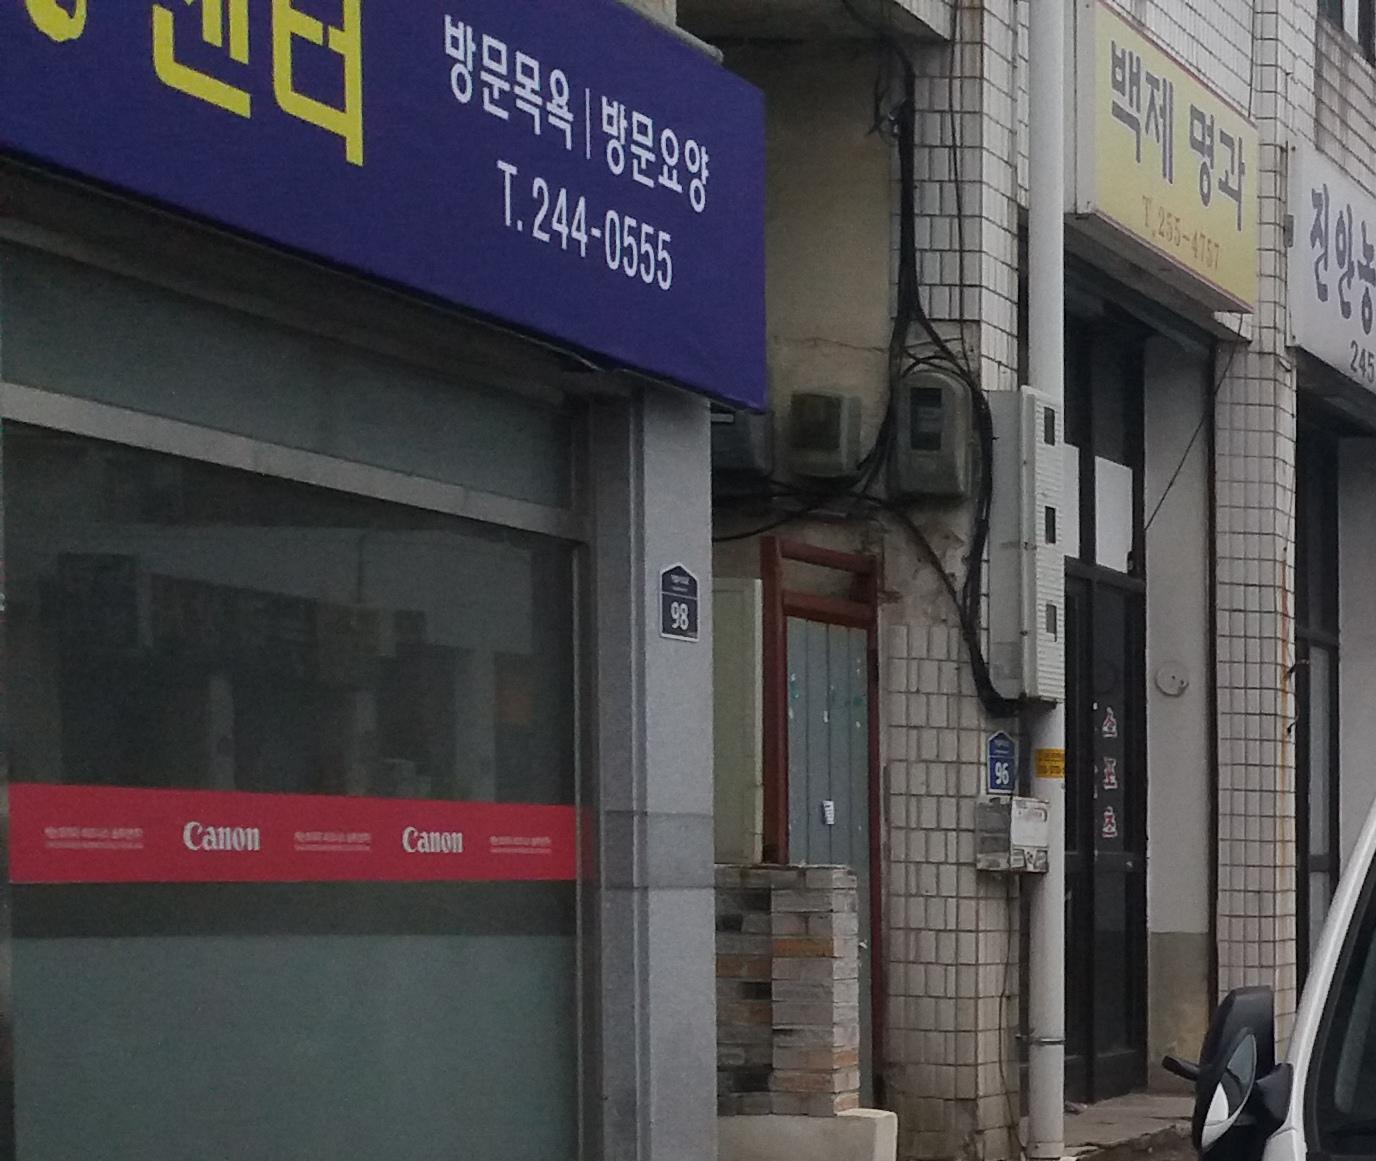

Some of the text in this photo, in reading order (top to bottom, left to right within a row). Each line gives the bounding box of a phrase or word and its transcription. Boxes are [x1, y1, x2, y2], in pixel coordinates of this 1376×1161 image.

[25, 0, 364, 167] 센터
[444, 14, 710, 213] 방문목욕 방문요양
[1111, 39, 1246, 232] 백제 명과
[670, 601, 689, 631] 98
[994, 761, 1010, 785] 96
[182, 820, 261, 853] Canon
[401, 825, 464, 854] Canon
